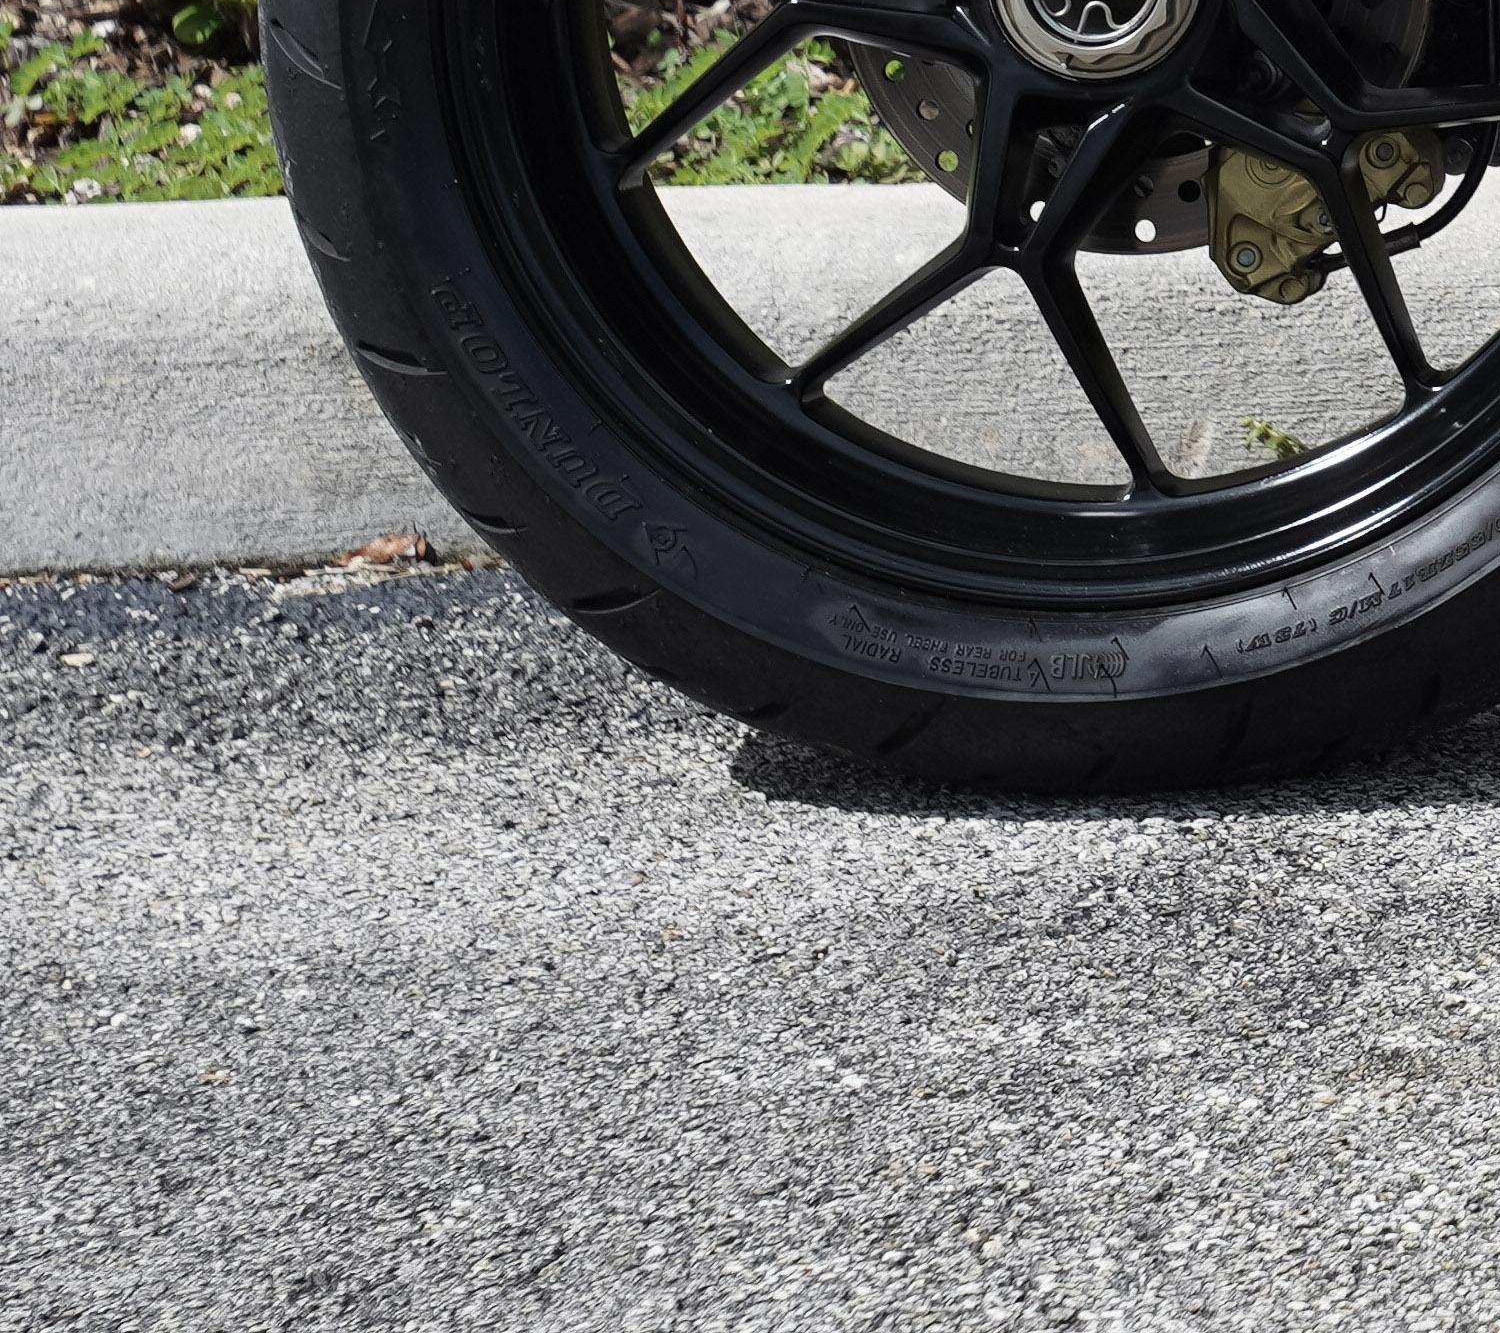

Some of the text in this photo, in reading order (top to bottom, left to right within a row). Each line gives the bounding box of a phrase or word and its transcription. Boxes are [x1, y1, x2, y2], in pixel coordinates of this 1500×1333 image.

[432, 277, 641, 520] DUNLOP
[870, 623, 898, 643] USE
[953, 641, 993, 661] REAR
[837, 629, 1022, 683] TUBELESS RADIAL
